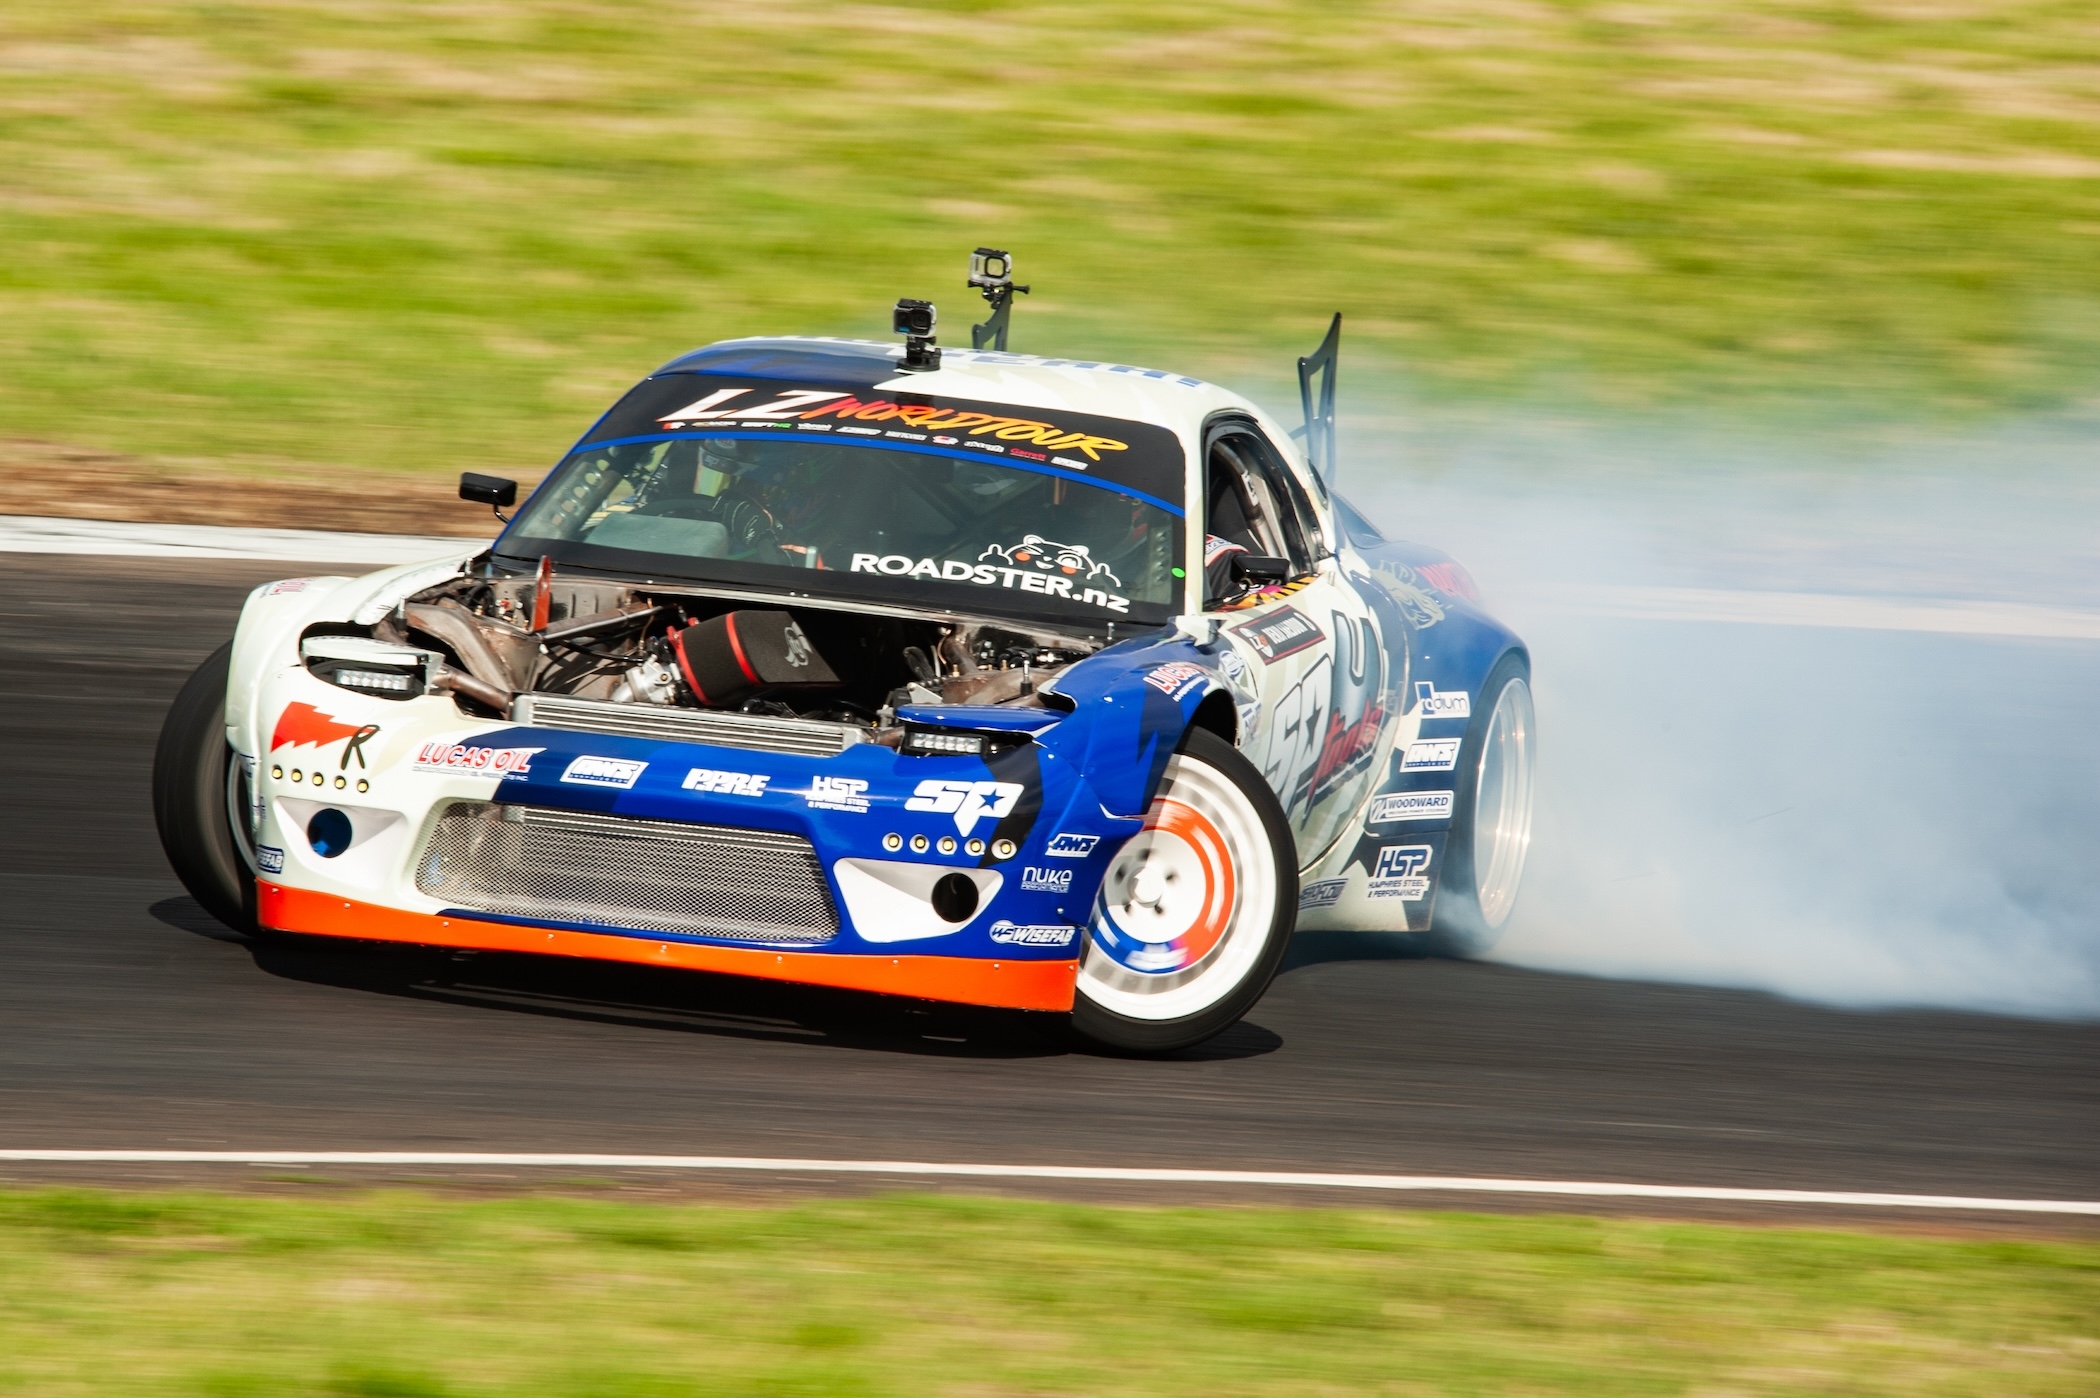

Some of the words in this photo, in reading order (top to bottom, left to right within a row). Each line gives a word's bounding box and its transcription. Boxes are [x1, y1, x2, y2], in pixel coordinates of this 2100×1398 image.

[656, 389, 853, 421] LZ
[850, 553, 1130, 613] ROADSTER.nz
[416, 742, 494, 769] LUCAS
[493, 750, 533, 773] OIL
[812, 775, 869, 797] HSP
[904, 780, 1024, 837] SP
[1388, 797, 1449, 809] WOODWARD
[1376, 849, 1428, 878] HSP
[1022, 866, 1073, 885] nuke
[1368, 880, 1402, 889] HUMPHRIES
[1374, 889, 1421, 897] PERFORMANCE
[1013, 927, 1075, 943] WISEFAB
